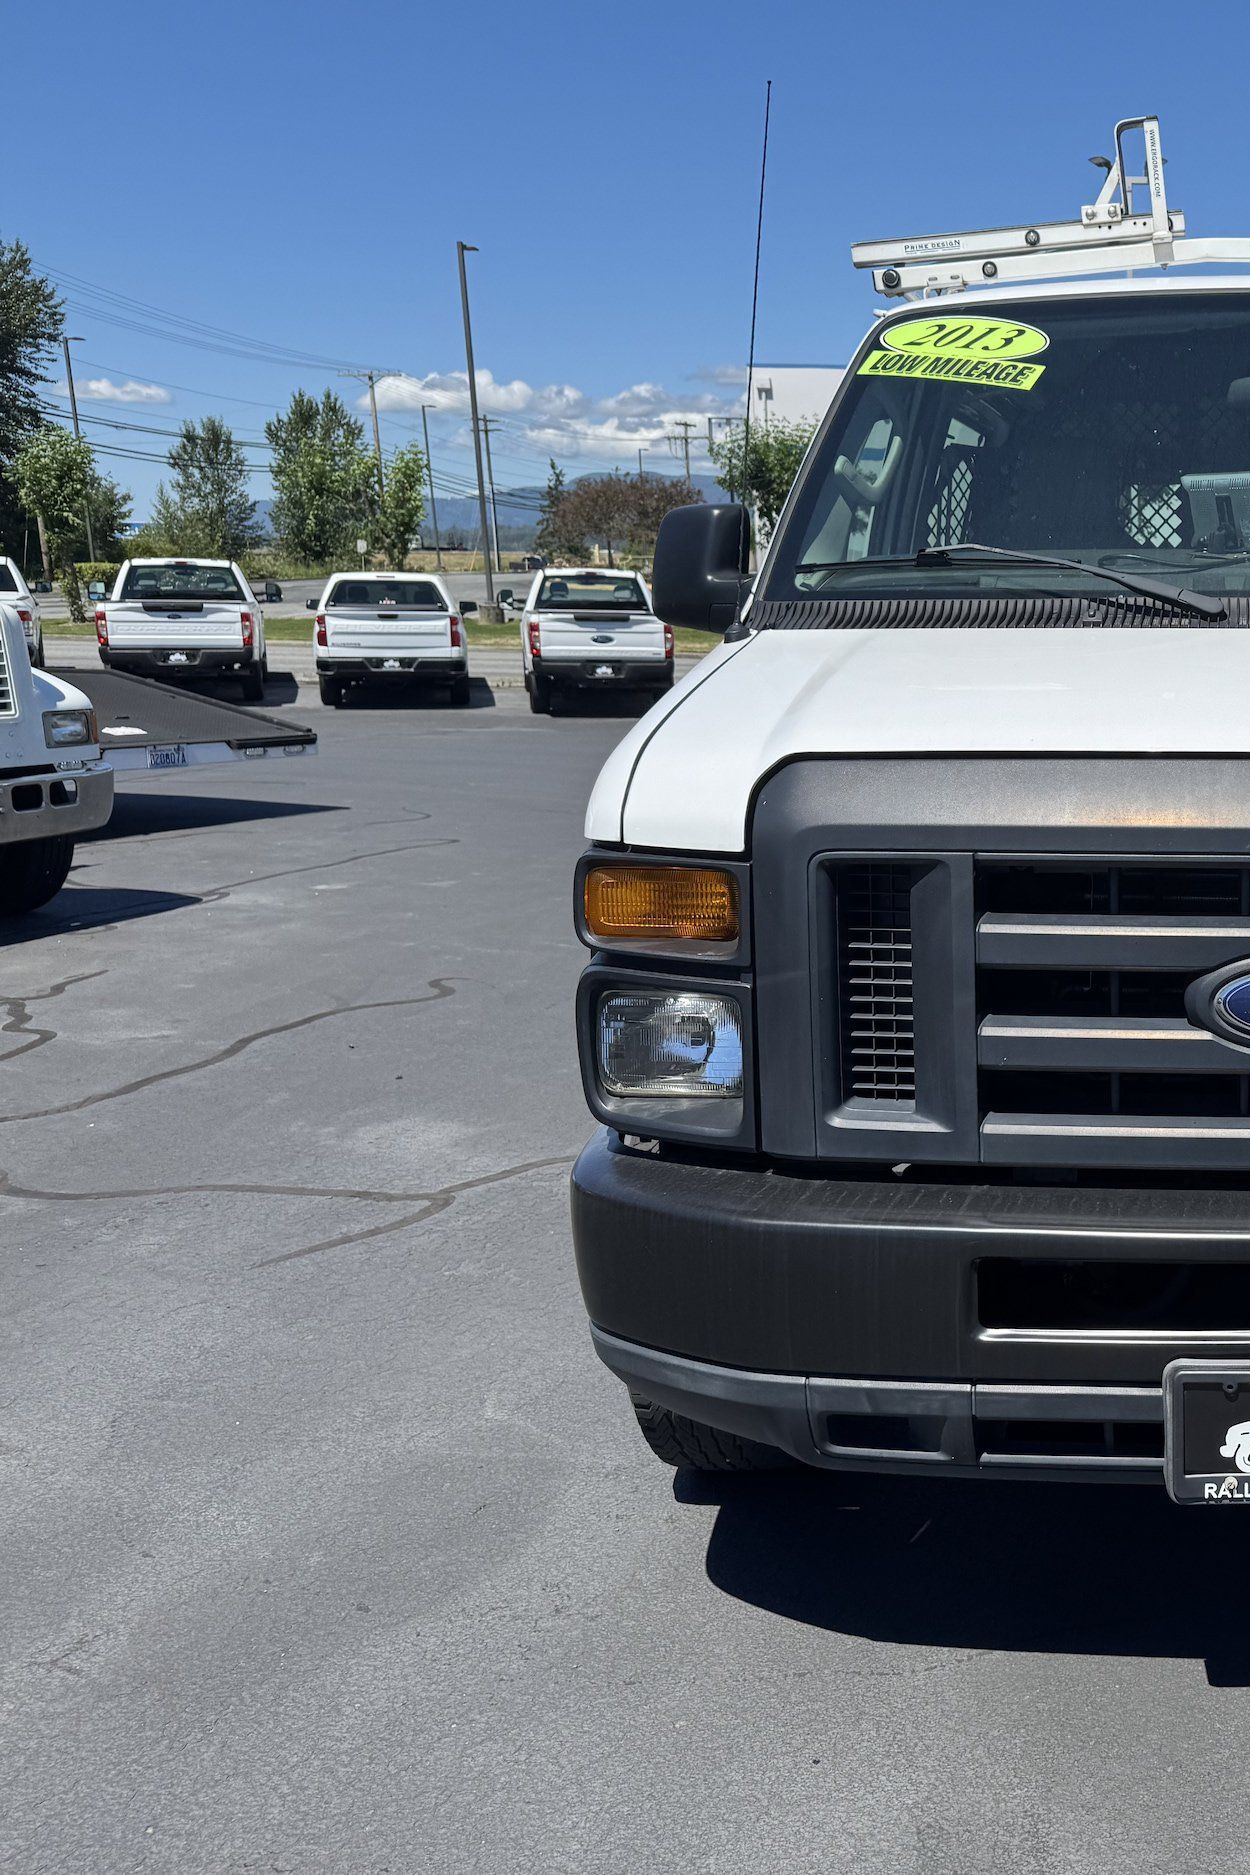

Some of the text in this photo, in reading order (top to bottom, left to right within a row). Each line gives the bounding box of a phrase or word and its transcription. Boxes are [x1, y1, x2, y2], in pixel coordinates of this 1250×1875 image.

[1149, 129, 1161, 197] WWW.ERGORACK.COM
[931, 240, 961, 248] DESIGN
[903, 324, 1027, 351] 2013
[868, 353, 1037, 386] LOW MILEAGE
